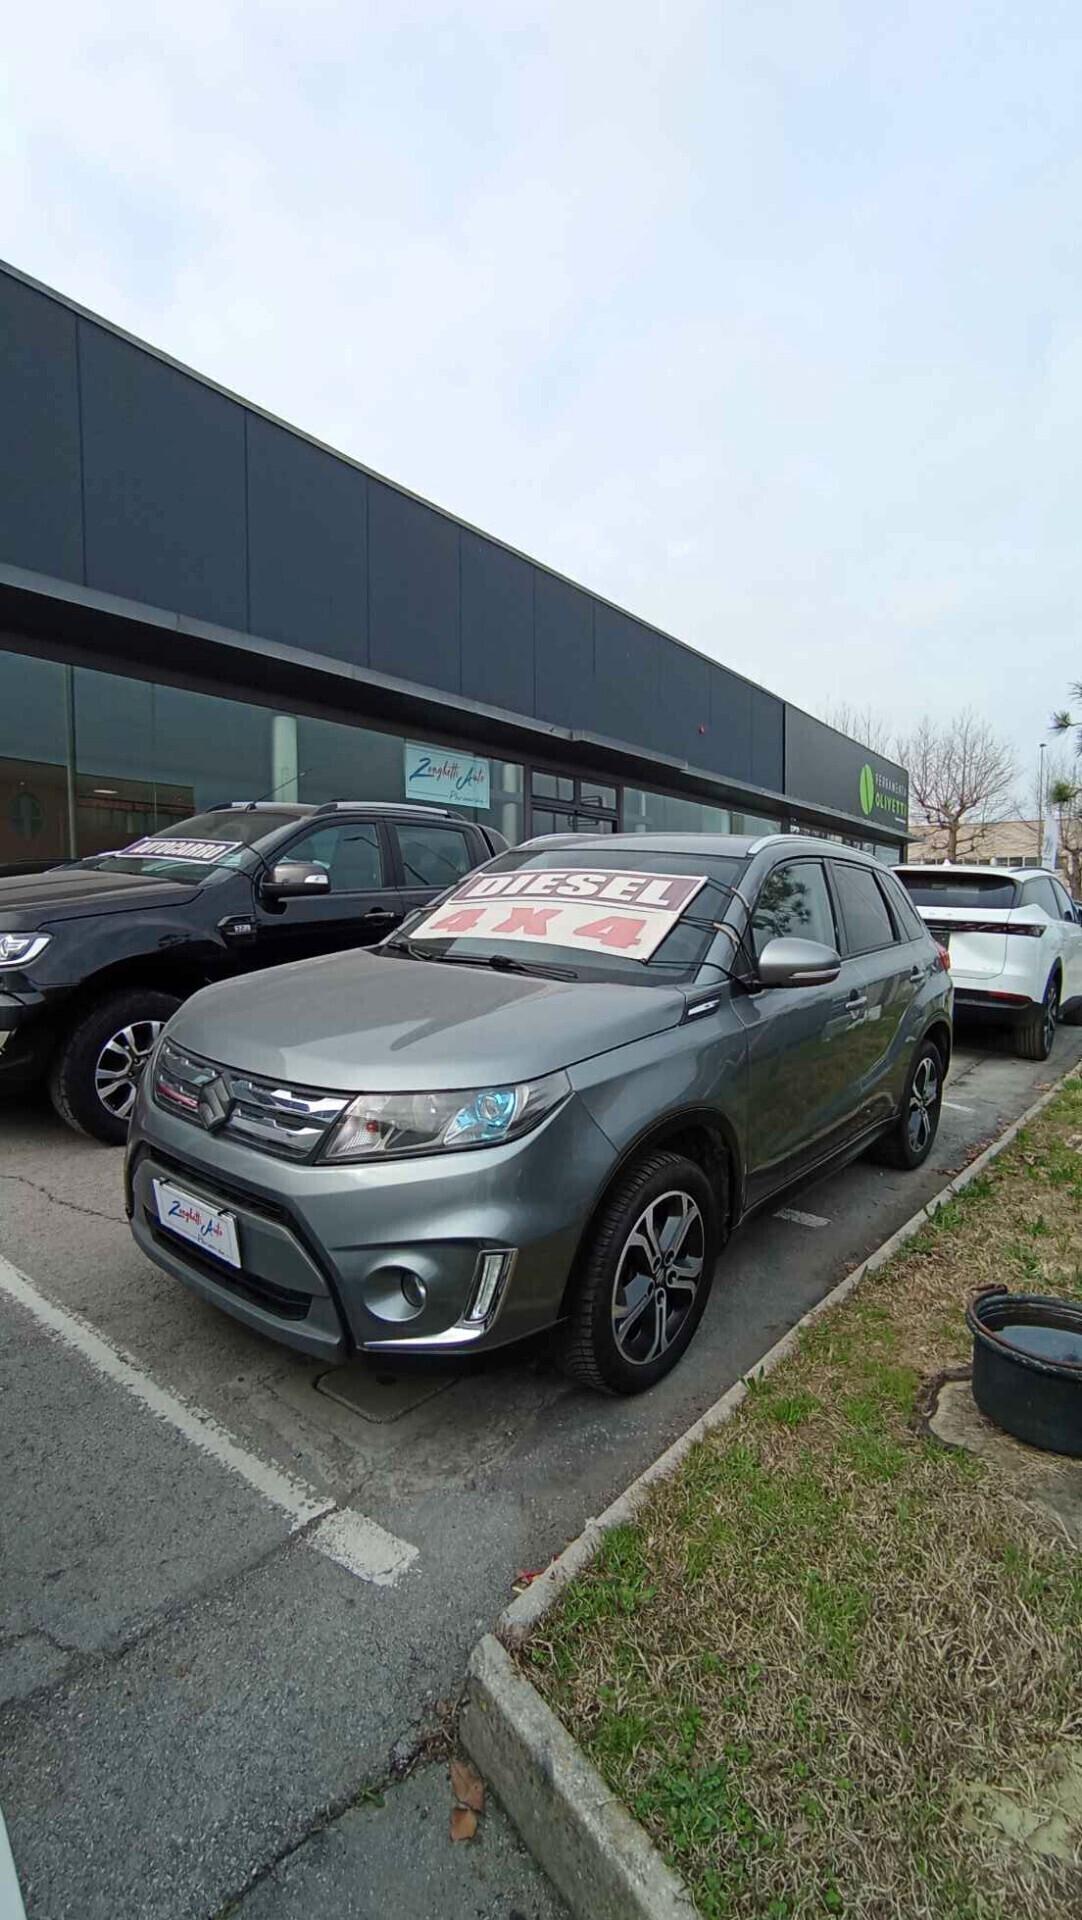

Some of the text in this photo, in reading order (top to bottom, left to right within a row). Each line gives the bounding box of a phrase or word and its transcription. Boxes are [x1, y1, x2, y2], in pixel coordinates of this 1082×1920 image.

[456, 767, 484, 790] Auto
[875, 791, 907, 817] OLIVETTI
[129, 841, 227, 859] AUTOCARRO
[466, 874, 675, 905] DIESEL
[429, 907, 648, 949] 4 X 4
[200, 1219, 224, 1237] Auto
